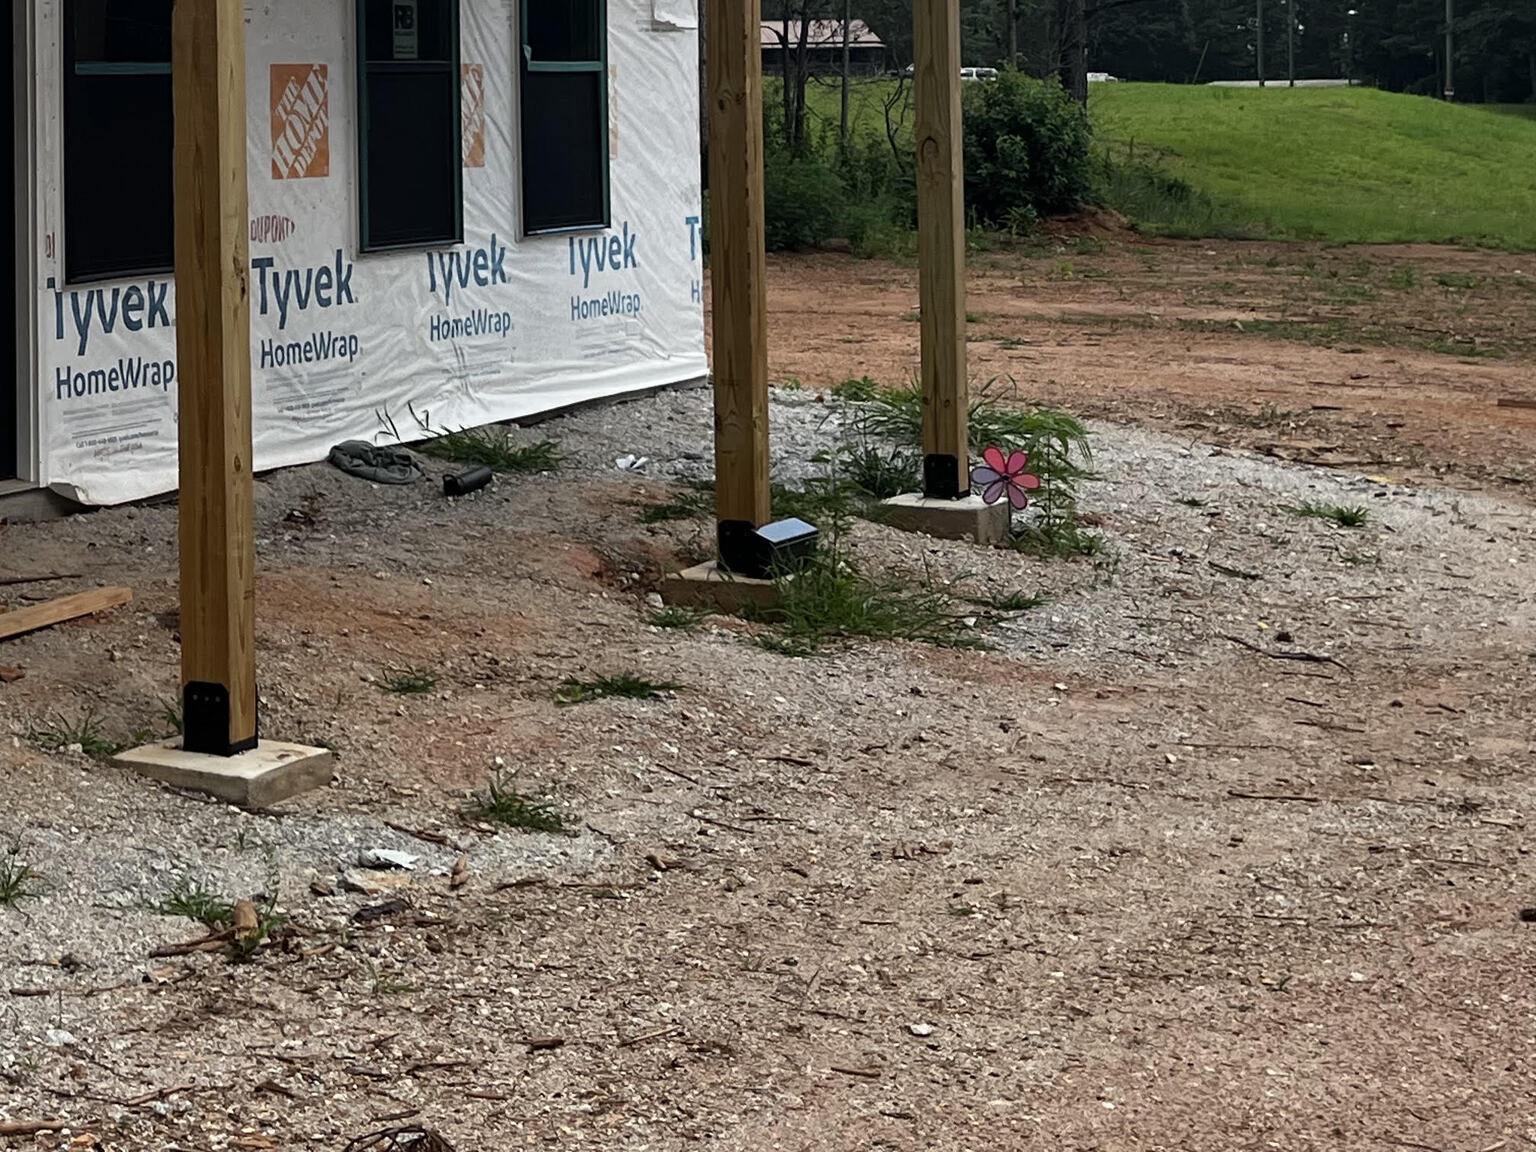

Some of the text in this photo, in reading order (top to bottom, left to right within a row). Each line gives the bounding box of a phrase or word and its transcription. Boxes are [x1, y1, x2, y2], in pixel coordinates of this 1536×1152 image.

[272, 63, 328, 179] HOME
[250, 215, 290, 243] DUPONT
[427, 233, 506, 307] Tyvek
[569, 221, 637, 288] Tyvek
[251, 249, 354, 330] Tyvek
[571, 291, 640, 321] HomeWrap
[430, 308, 511, 342] HomeWrap
[260, 331, 358, 369] HomeWrap
[56, 357, 174, 400] HomeWrap
